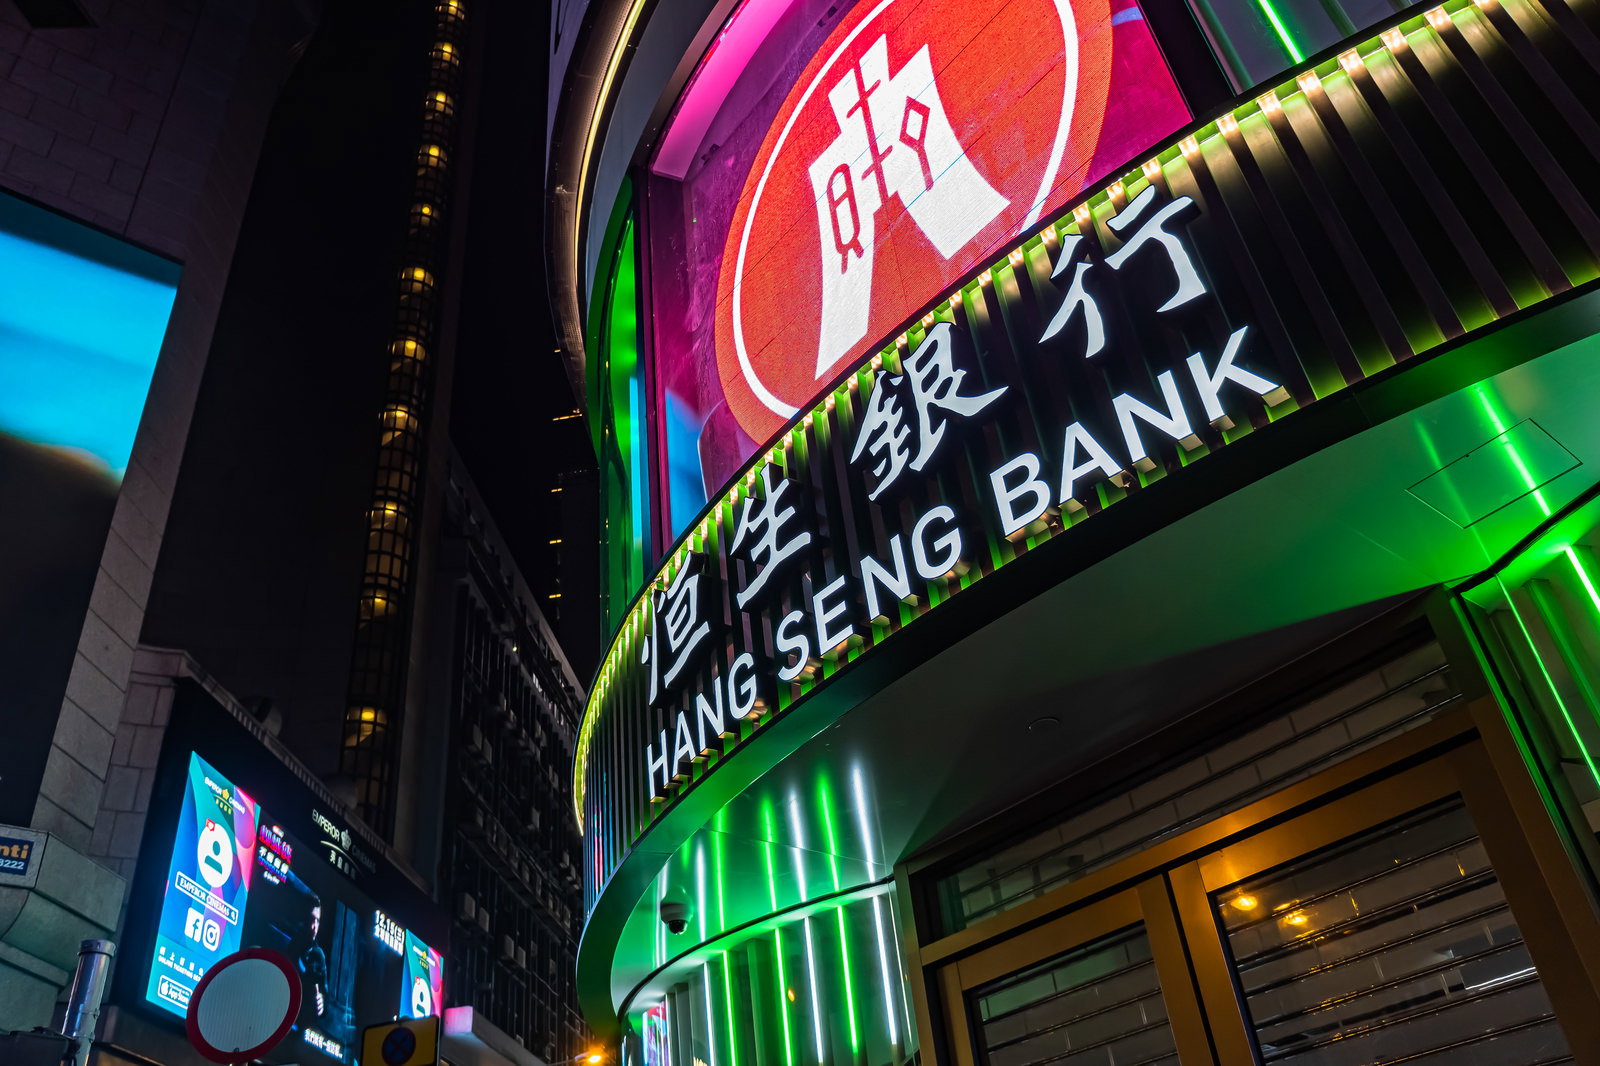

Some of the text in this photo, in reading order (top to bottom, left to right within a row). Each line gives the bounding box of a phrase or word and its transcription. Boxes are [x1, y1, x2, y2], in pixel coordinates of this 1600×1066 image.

[641, 184, 1208, 706] 恒生銀行
[646, 325, 1280, 801] HANG SENG BANK
[179, 877, 230, 917] EMPEROR CINEMAS
[311, 808, 340, 843] EMPEROR
